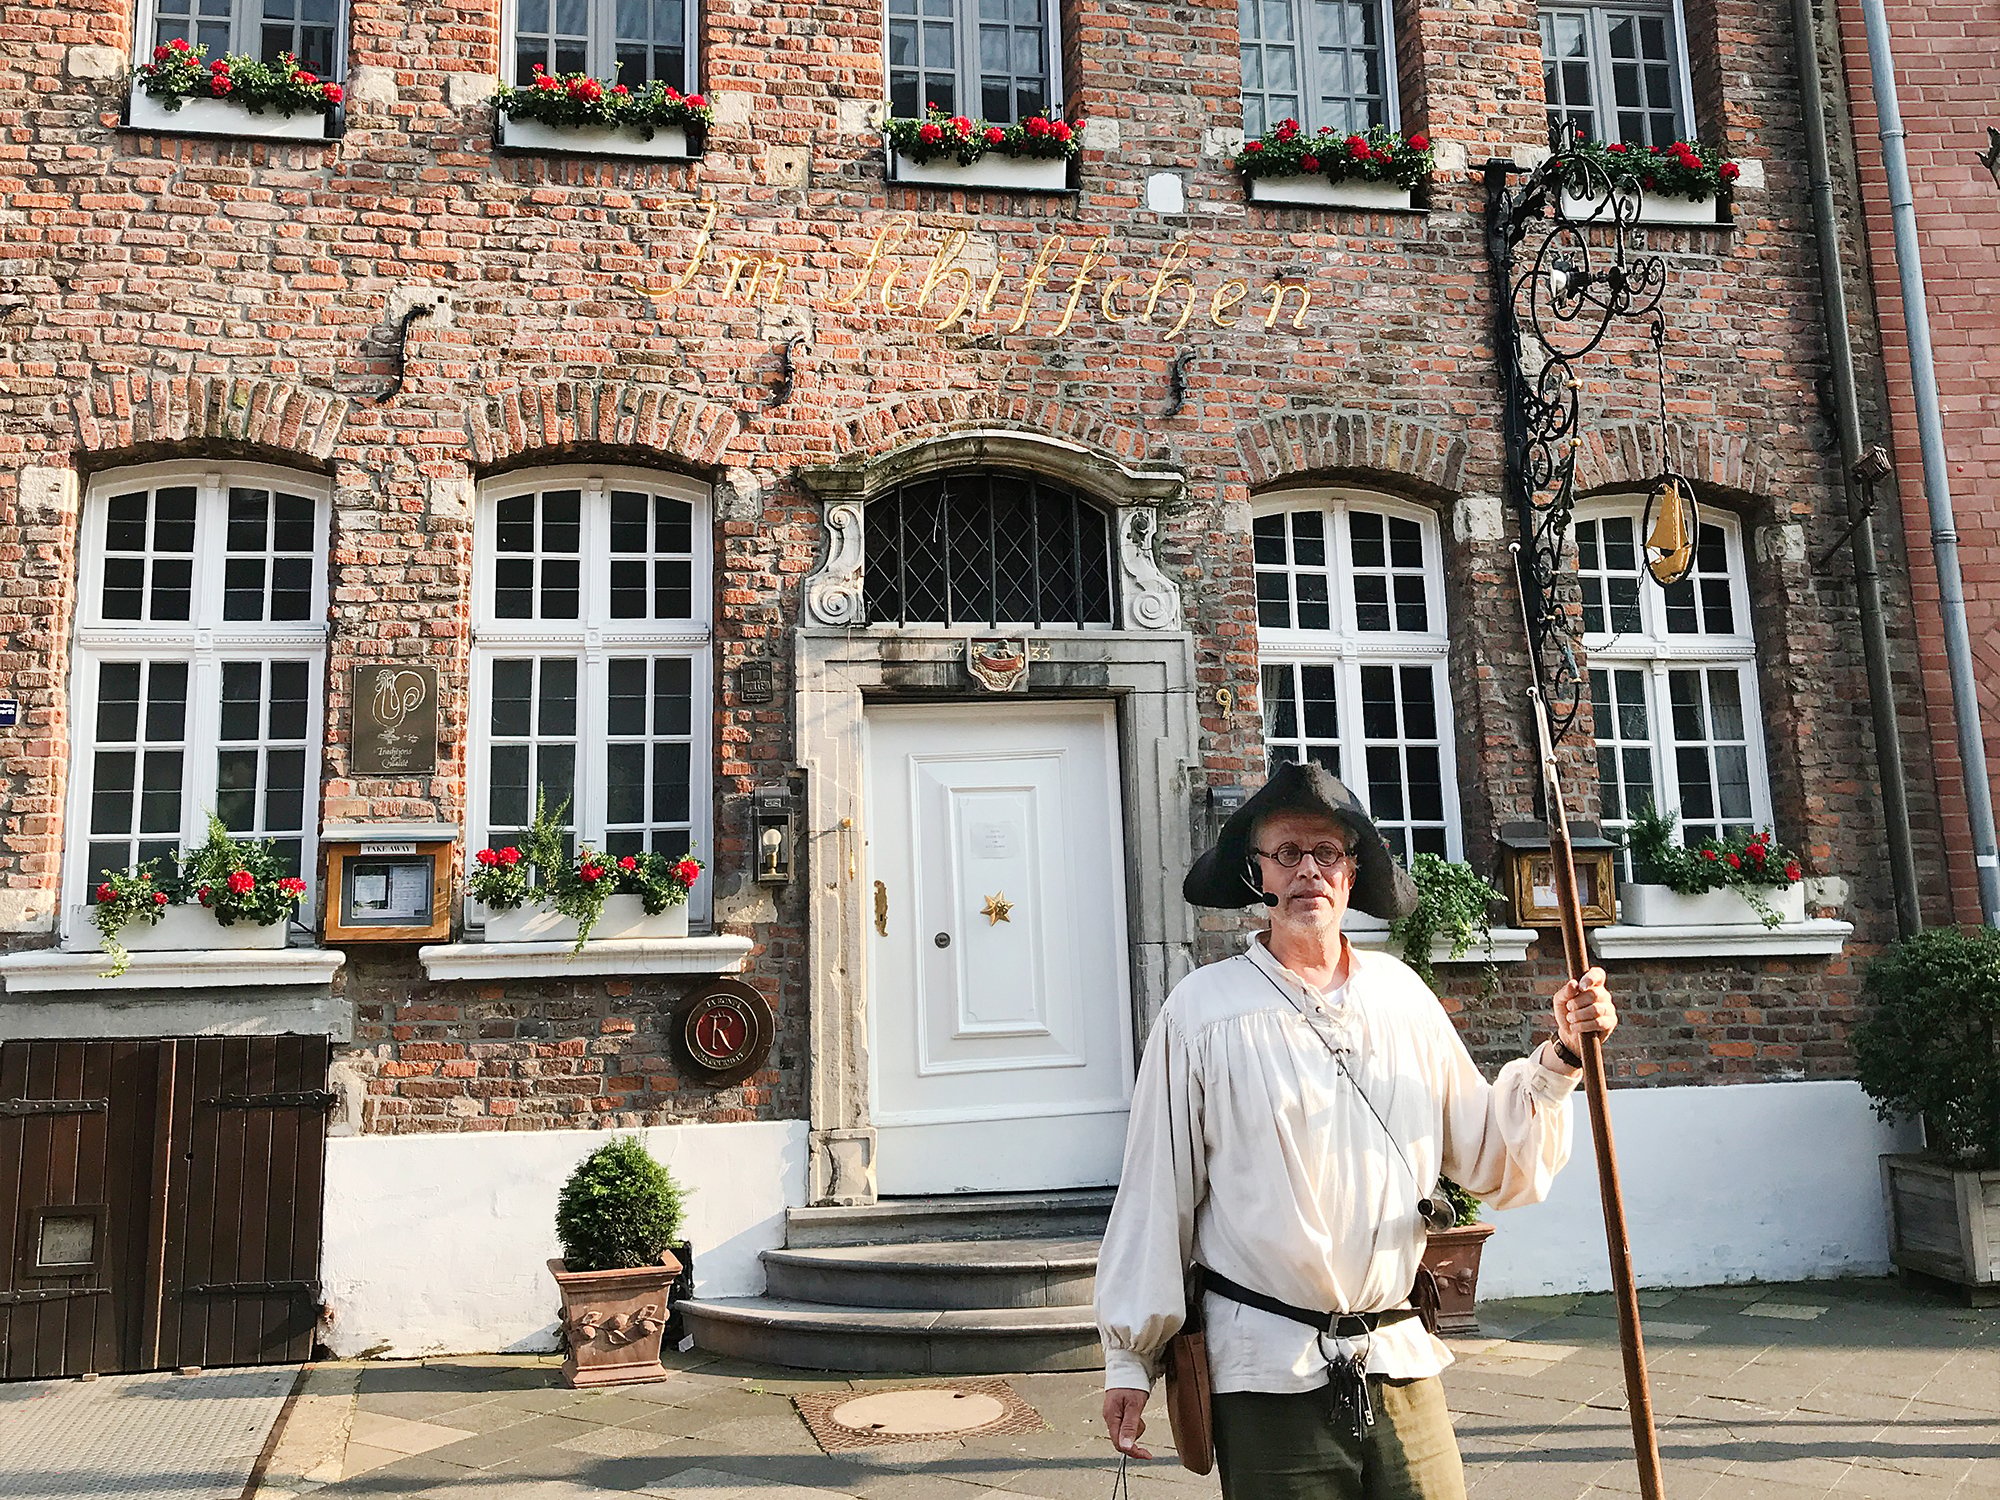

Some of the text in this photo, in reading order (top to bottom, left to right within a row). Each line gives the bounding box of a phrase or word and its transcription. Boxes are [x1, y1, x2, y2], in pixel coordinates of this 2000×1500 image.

[825, 216, 1312, 340] Schiffchen
[947, 646, 1051, 660] 17 33
[1216, 688, 1232, 720] 9
